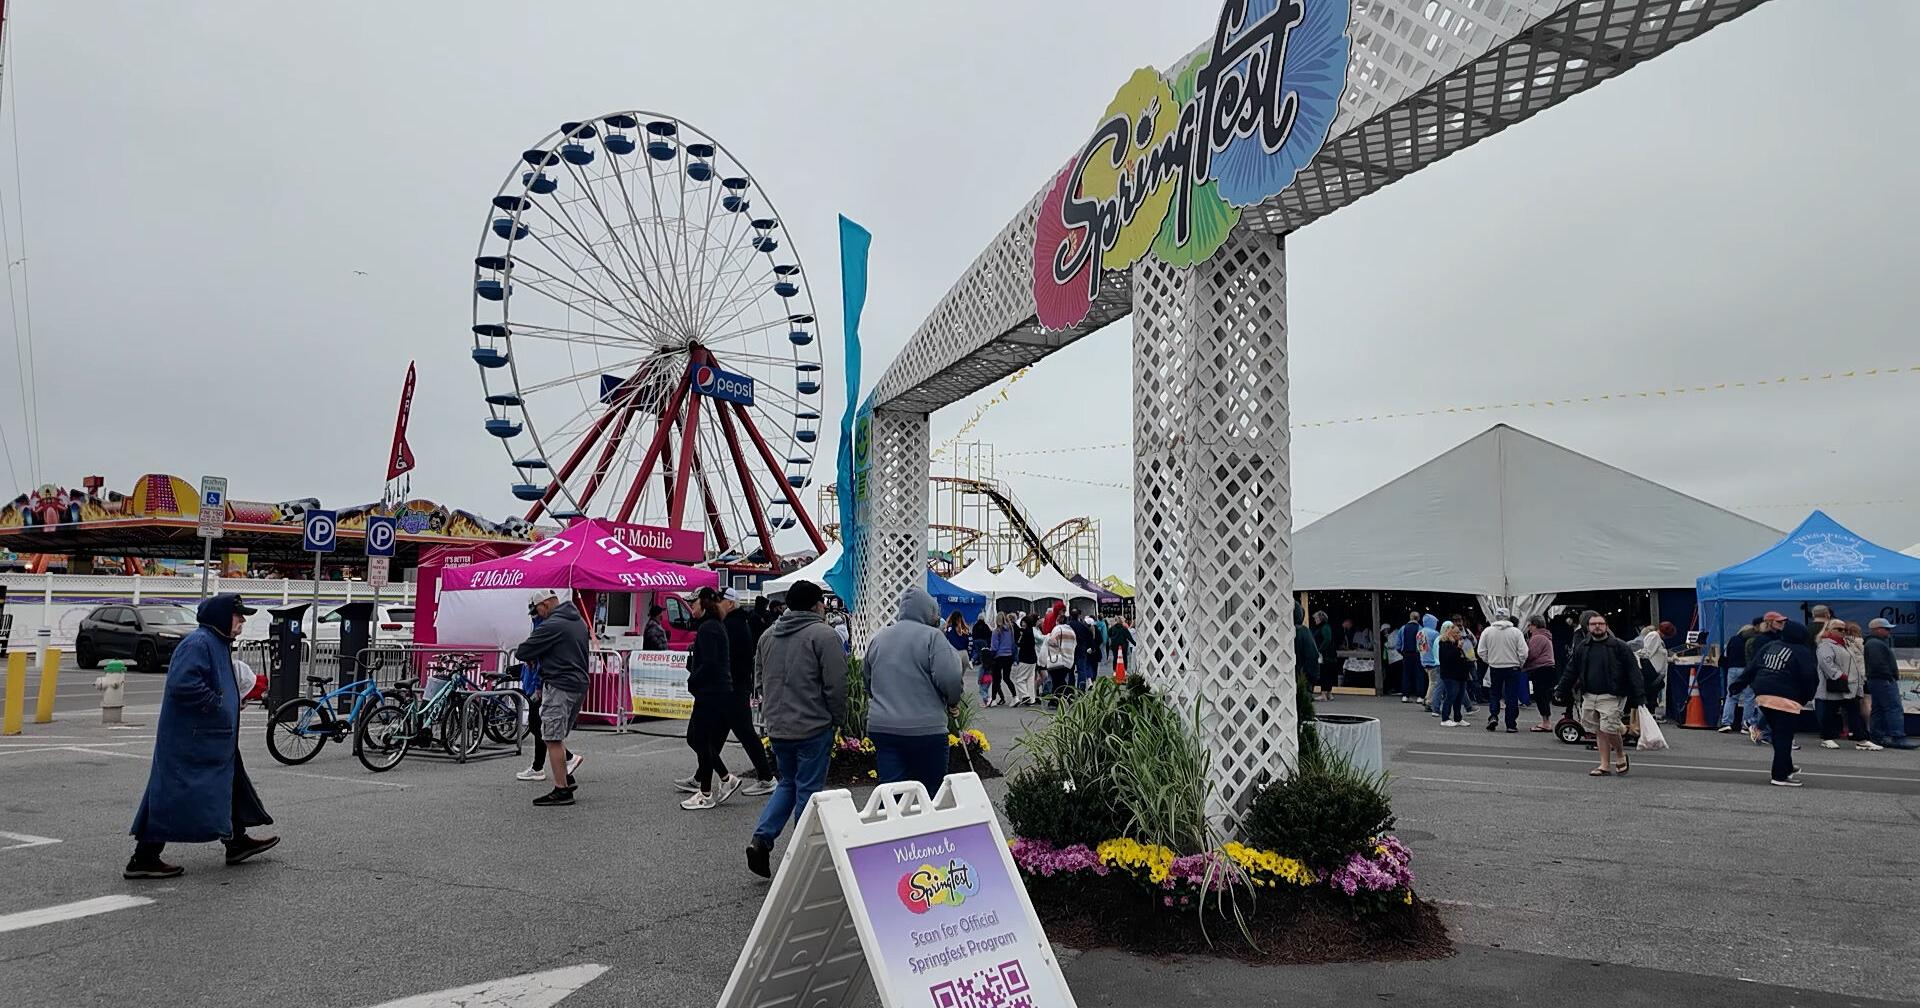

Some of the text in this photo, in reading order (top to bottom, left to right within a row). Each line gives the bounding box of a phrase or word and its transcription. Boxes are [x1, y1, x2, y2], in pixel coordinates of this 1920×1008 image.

[1053, 0, 1303, 302] Springfest
[716, 377, 752, 398] pepsi
[315, 521, 330, 540] P
[377, 527, 390, 545] P
[1781, 578, 1910, 593] Chesapeake Jewelers
[290, 621, 299, 632] P
[637, 653, 671, 662] PRESERVE
[893, 836, 956, 863] Welcome to
[910, 859, 973, 908] Springfest
[910, 910, 1000, 947] Scan for Official
[908, 932, 1018, 975] Springfest Program
